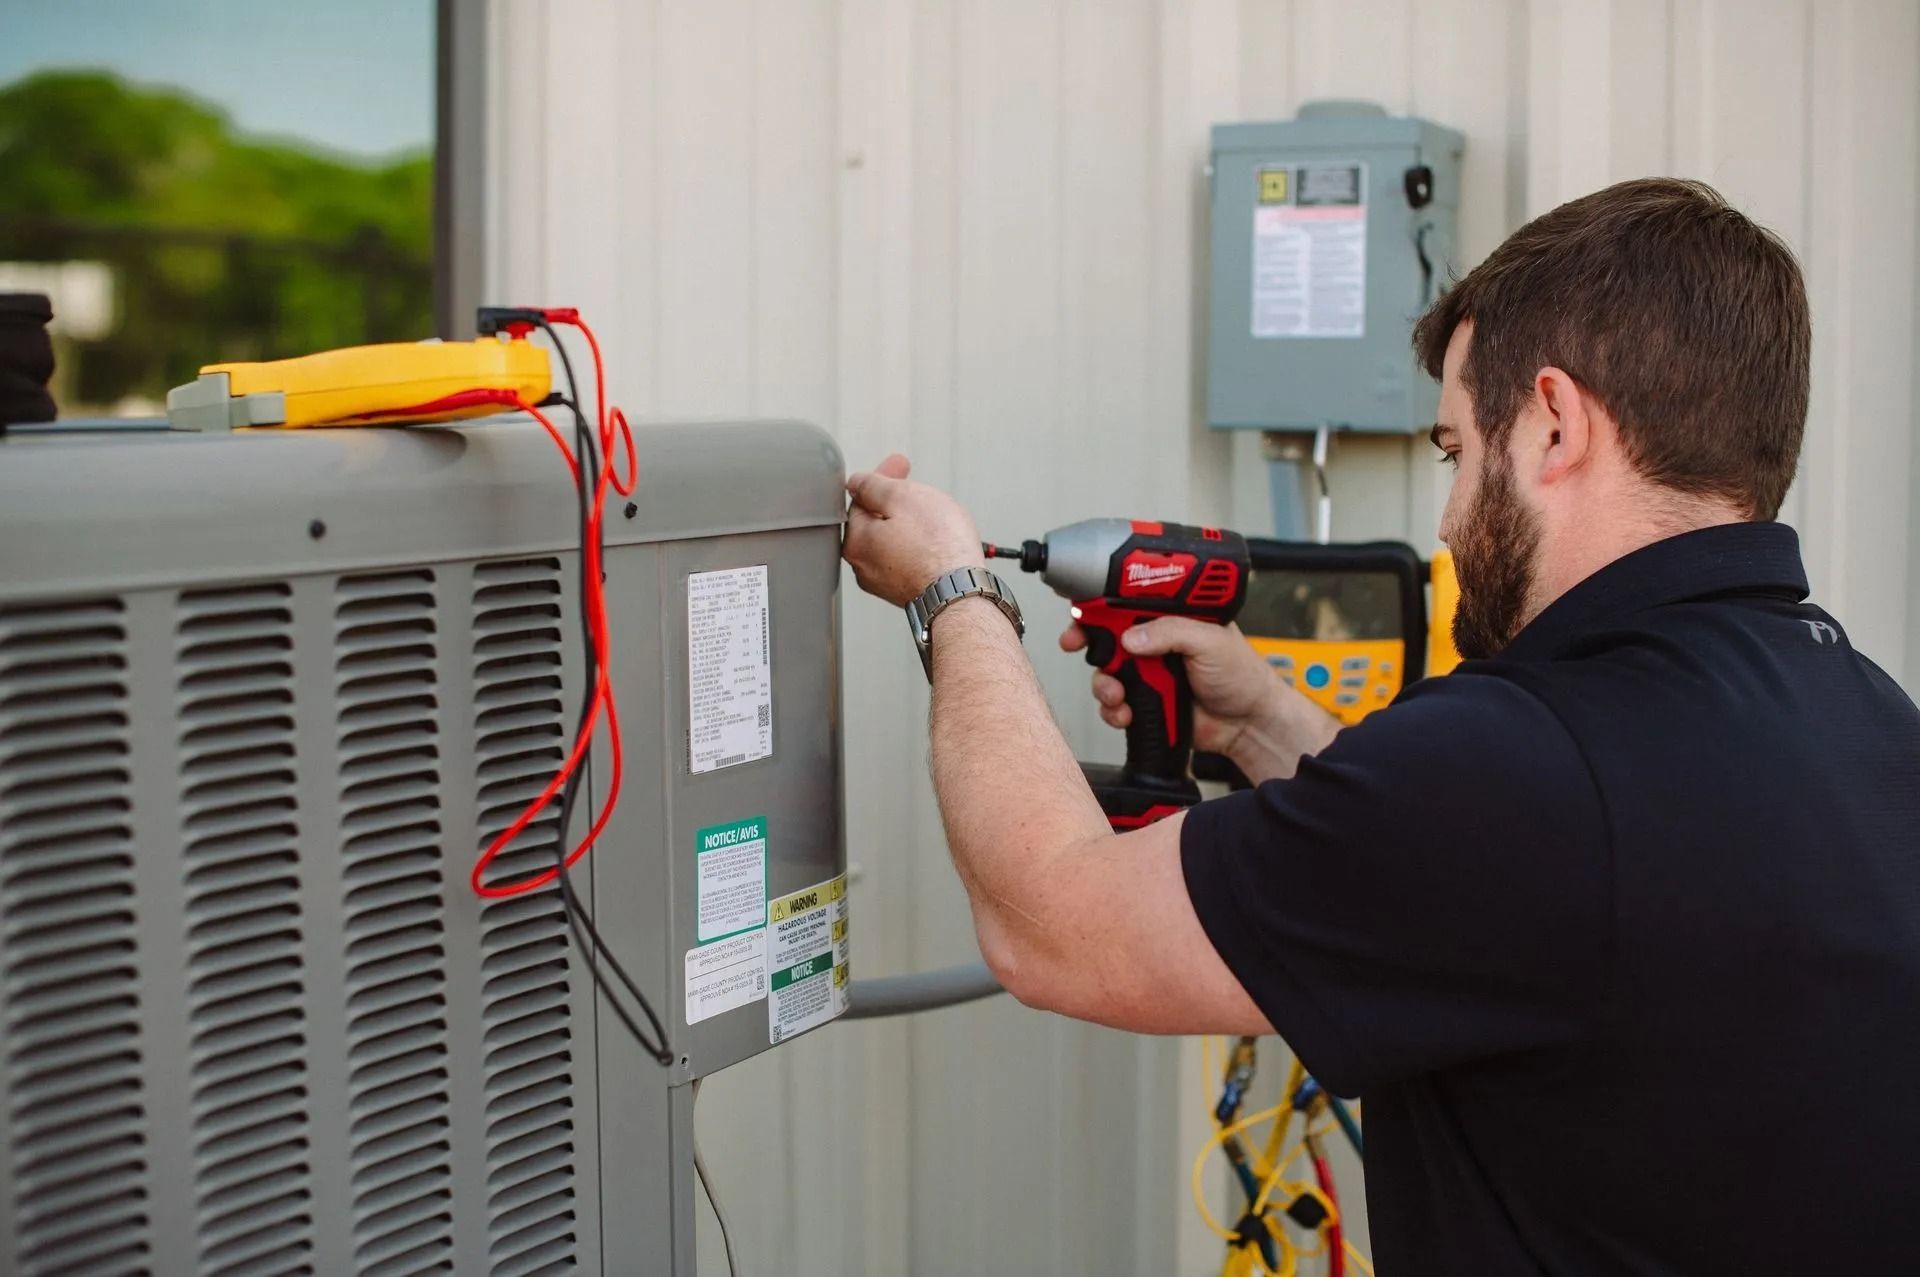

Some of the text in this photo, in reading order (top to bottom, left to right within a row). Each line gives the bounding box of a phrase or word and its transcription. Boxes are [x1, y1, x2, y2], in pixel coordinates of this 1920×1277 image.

[1126, 563, 1185, 582] Milwaukee
[705, 824, 759, 849] NOTICE/AVIS
[789, 892, 818, 914] WARNING
[778, 915, 807, 933] HAZARDOUS
[808, 908, 826, 922] VOLTAGE
[791, 960, 813, 982] NOTICE
